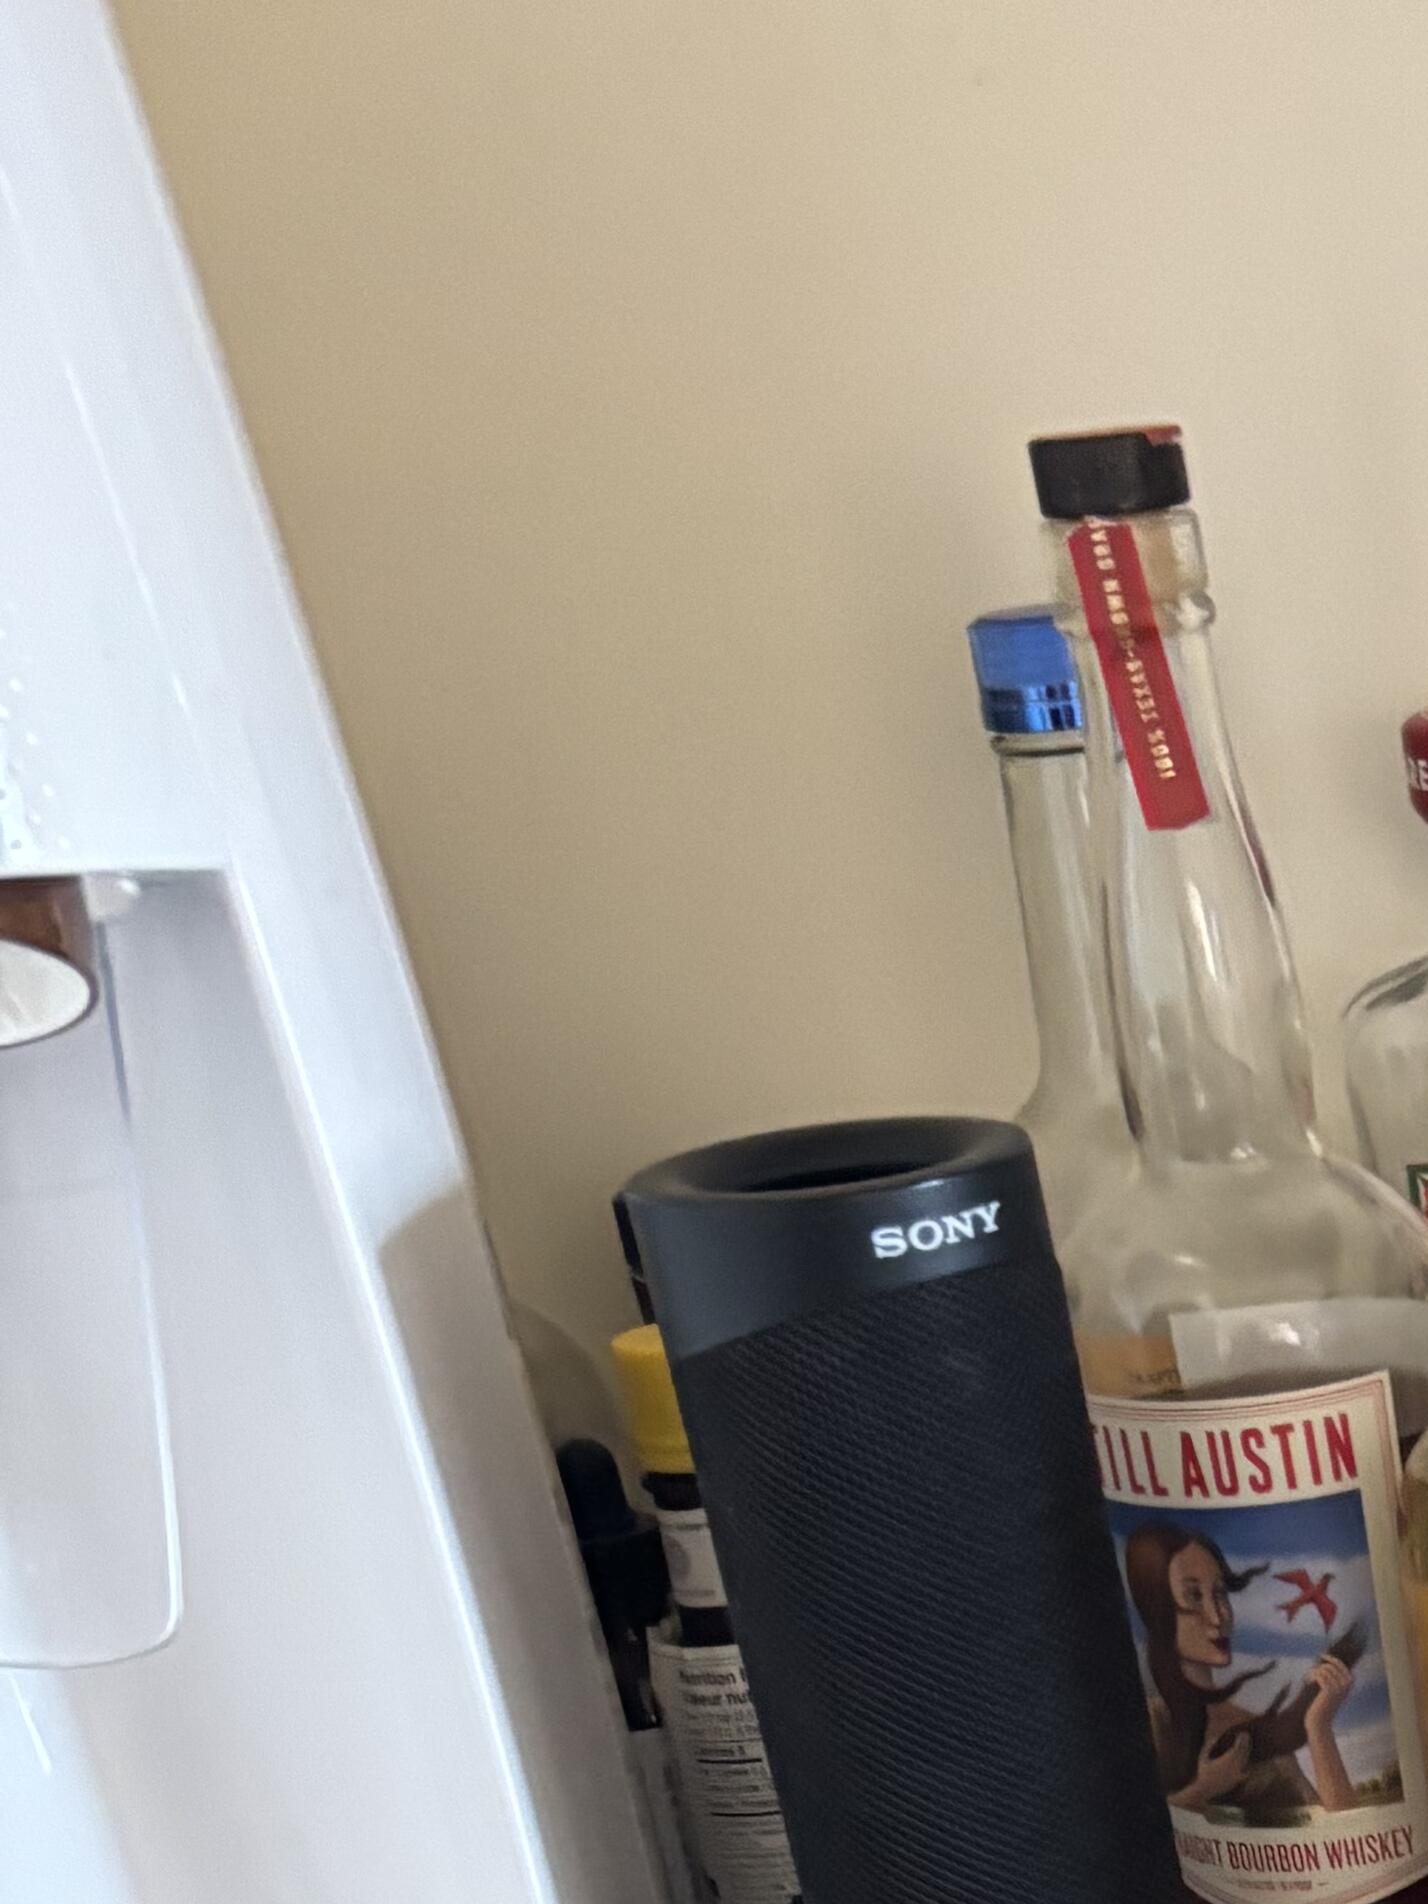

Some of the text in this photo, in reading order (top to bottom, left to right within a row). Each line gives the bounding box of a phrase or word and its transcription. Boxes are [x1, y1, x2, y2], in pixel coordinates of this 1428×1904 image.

[870, 1199, 1003, 1262] SONY
[1179, 1412, 1358, 1499] AUSTIN
[1226, 1825, 1415, 1873] BOURBON WHISKEY
